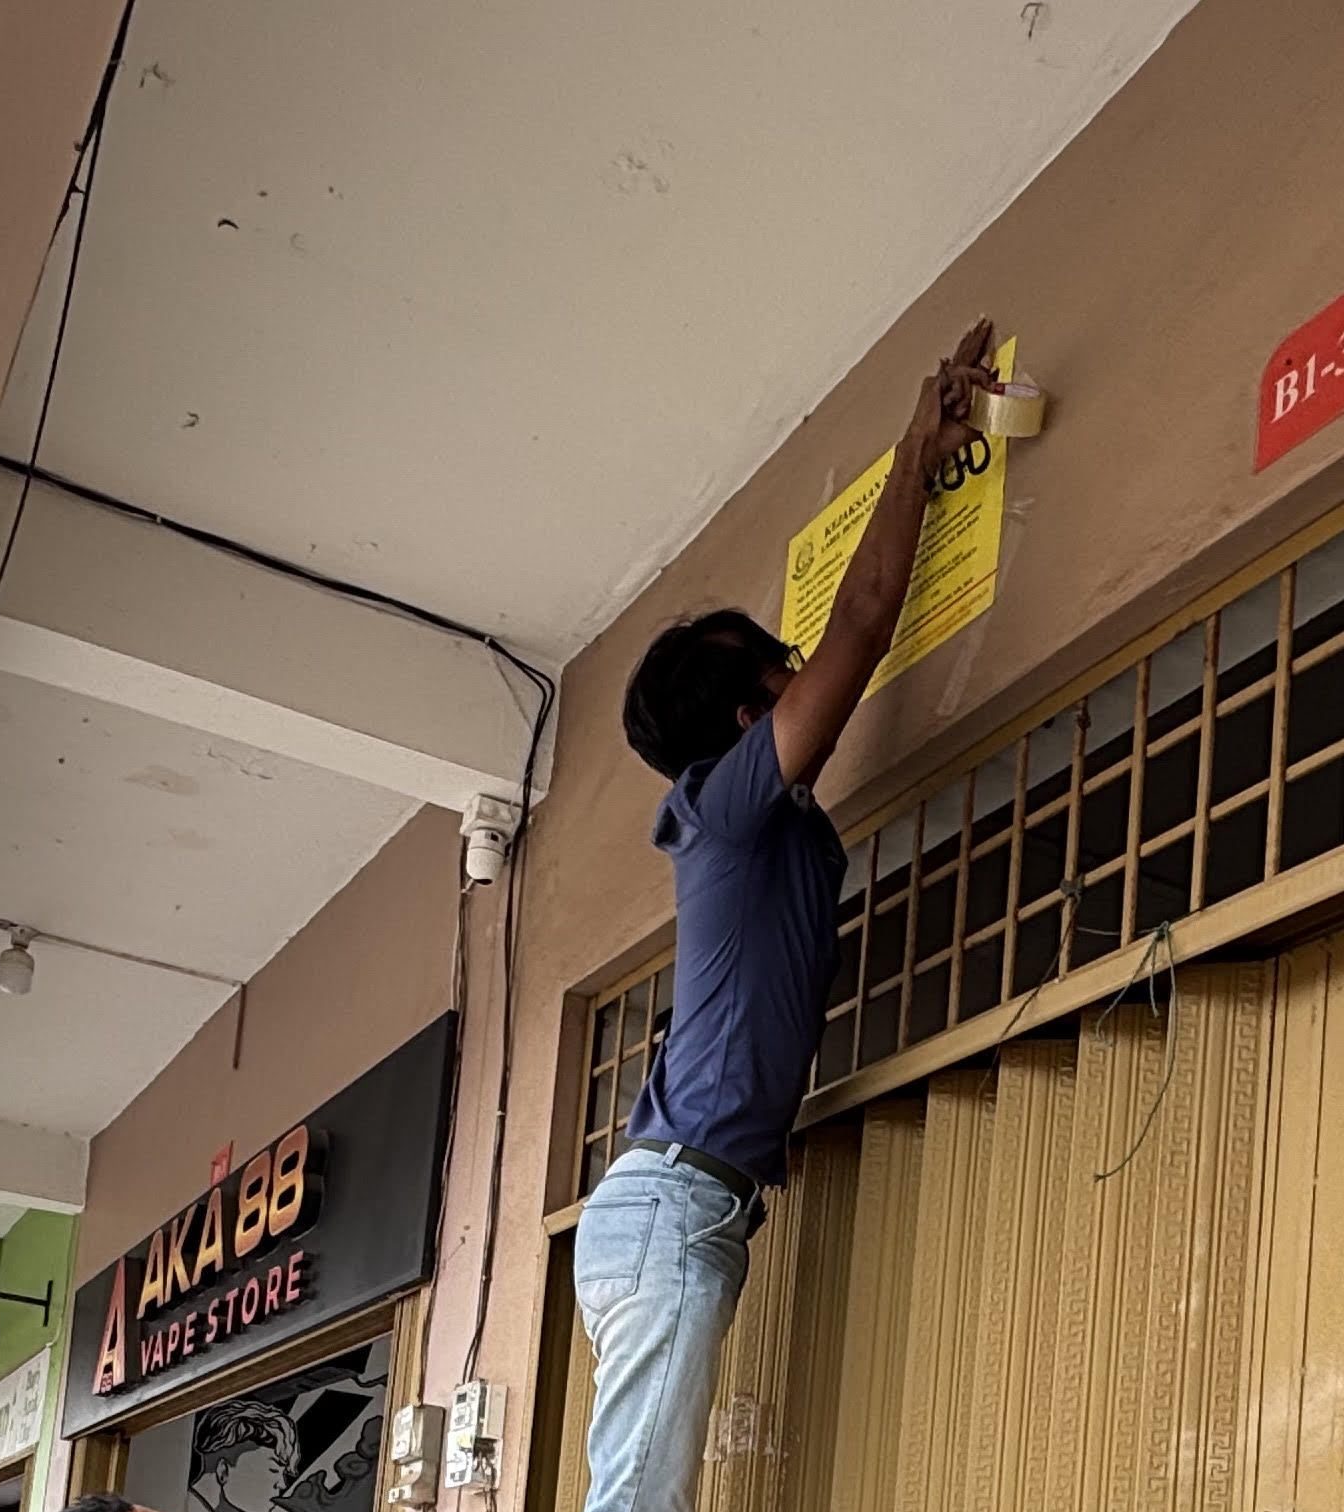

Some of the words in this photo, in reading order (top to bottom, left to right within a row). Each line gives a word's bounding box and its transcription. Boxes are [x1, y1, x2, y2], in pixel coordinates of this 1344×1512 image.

[137, 1187, 224, 1320] AKA
[235, 1124, 310, 1258] 88
[141, 1311, 197, 1377] VAPE
[206, 1250, 304, 1344] STORE
